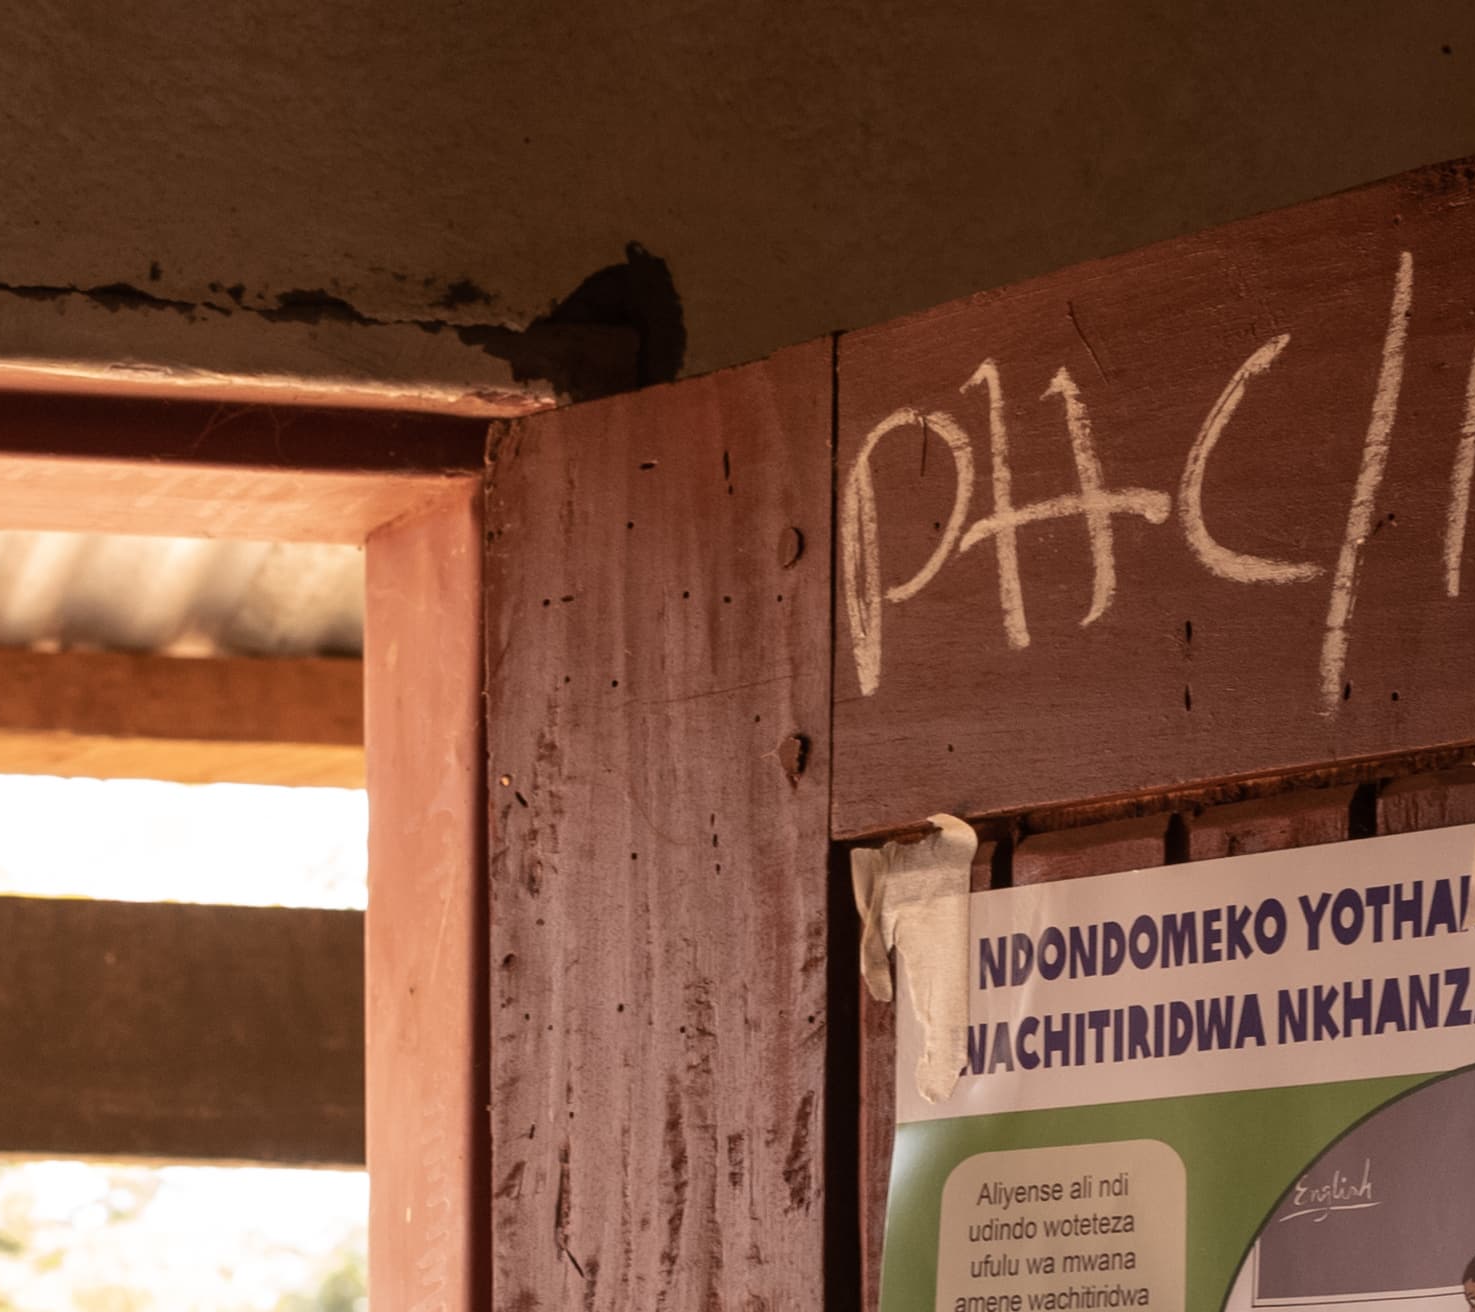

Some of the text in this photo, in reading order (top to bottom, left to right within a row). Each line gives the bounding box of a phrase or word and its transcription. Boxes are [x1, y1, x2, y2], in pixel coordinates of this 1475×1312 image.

[978, 897, 1287, 990] NDONDOMEKO
[977, 1173, 1128, 1210] Aliyense ali ndi
[969, 1213, 1134, 1242] udindo woteteza
[971, 1252, 1136, 1278] ufulu wa mwana
[1028, 1284, 1149, 1311] wachitiridwa
